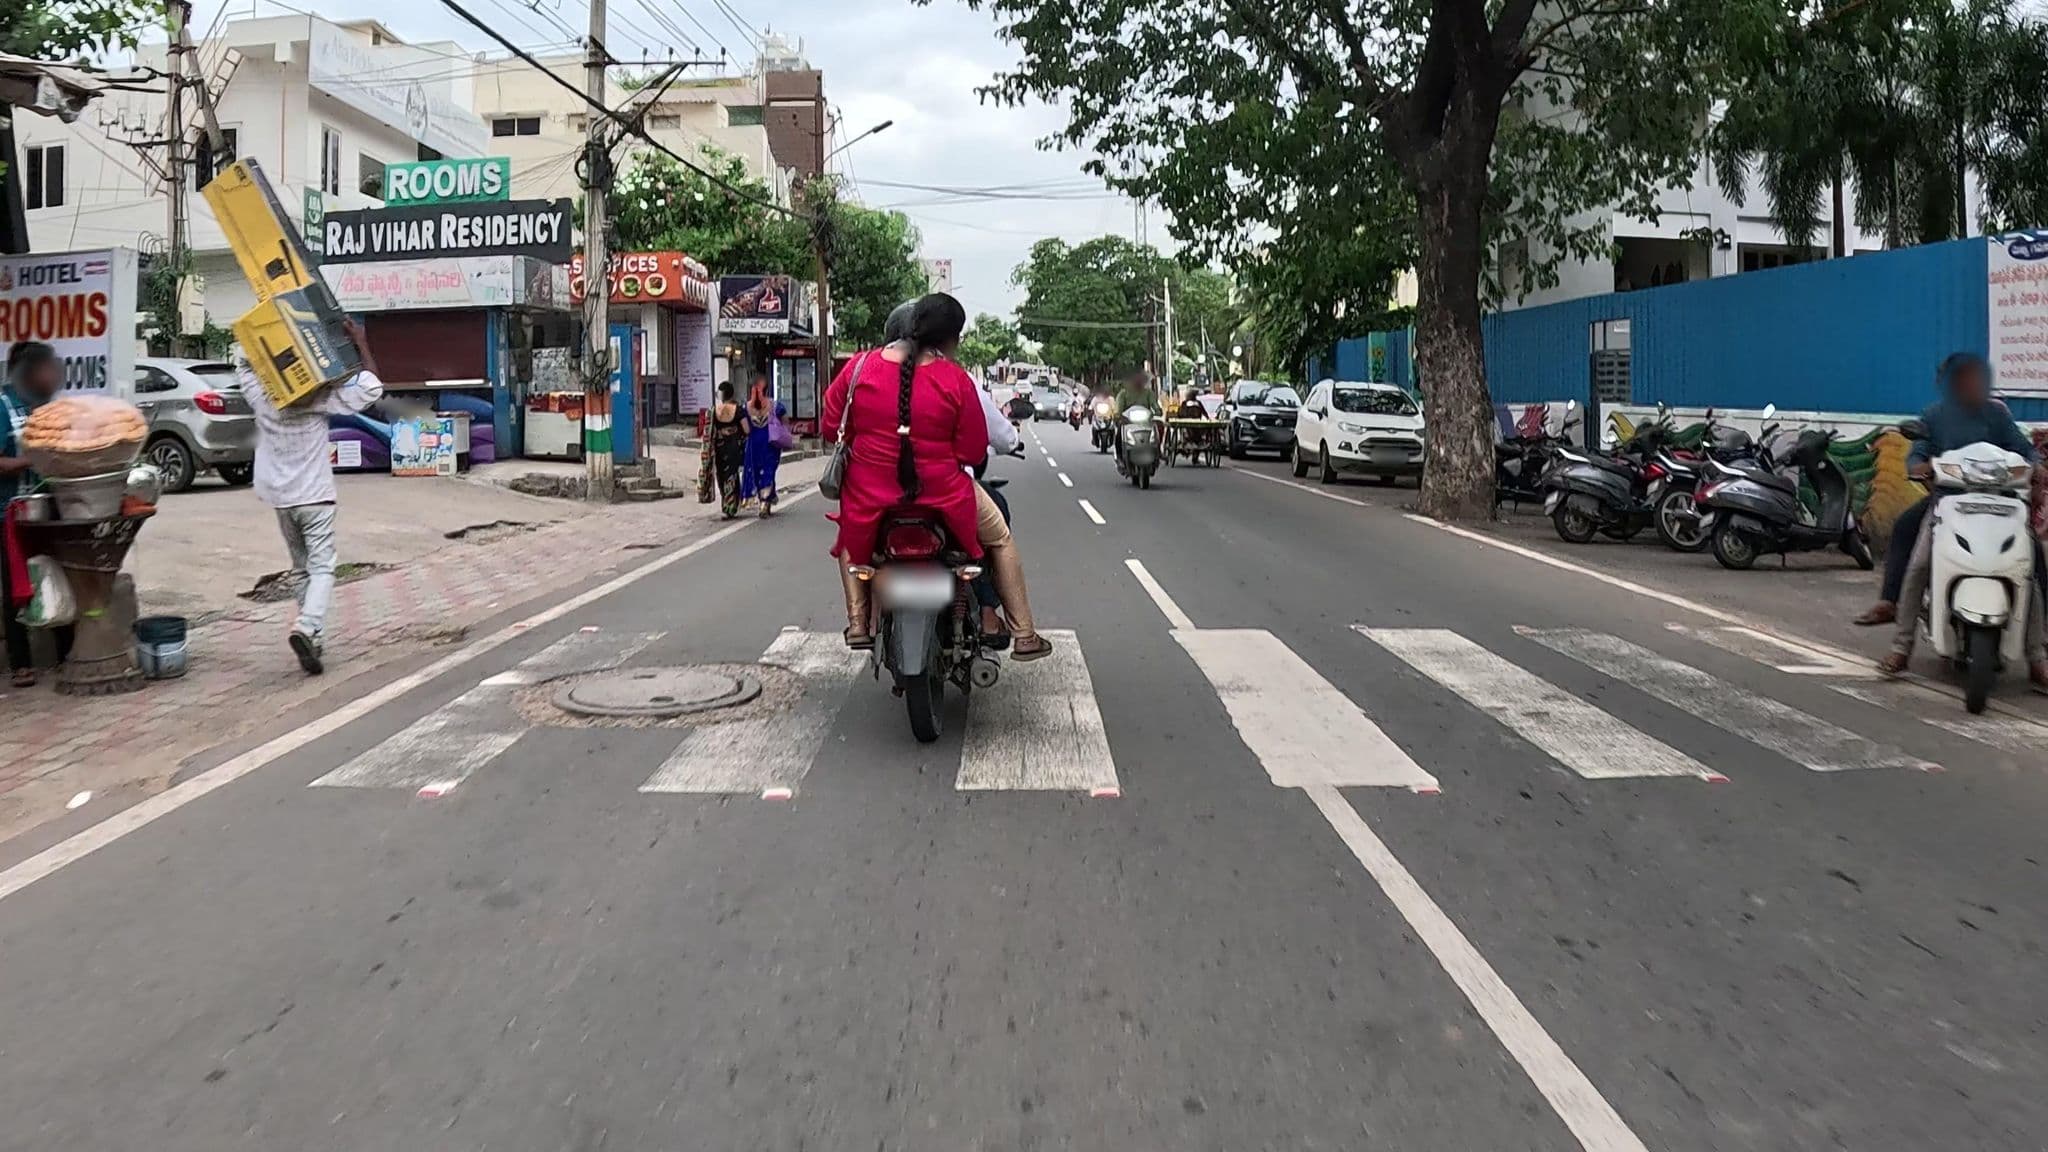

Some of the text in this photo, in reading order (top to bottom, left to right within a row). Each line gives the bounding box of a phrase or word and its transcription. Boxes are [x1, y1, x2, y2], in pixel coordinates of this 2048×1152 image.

[388, 162, 502, 200] ROOMS
[326, 221, 366, 256] RAJ
[371, 219, 435, 253] VIHAR
[440, 212, 563, 249] RESIDENCY
[18, 262, 82, 287] HOTEL
[606, 255, 659, 273] PICES
[0, 291, 108, 342] ROOMS
[59, 355, 106, 390] OOMS
